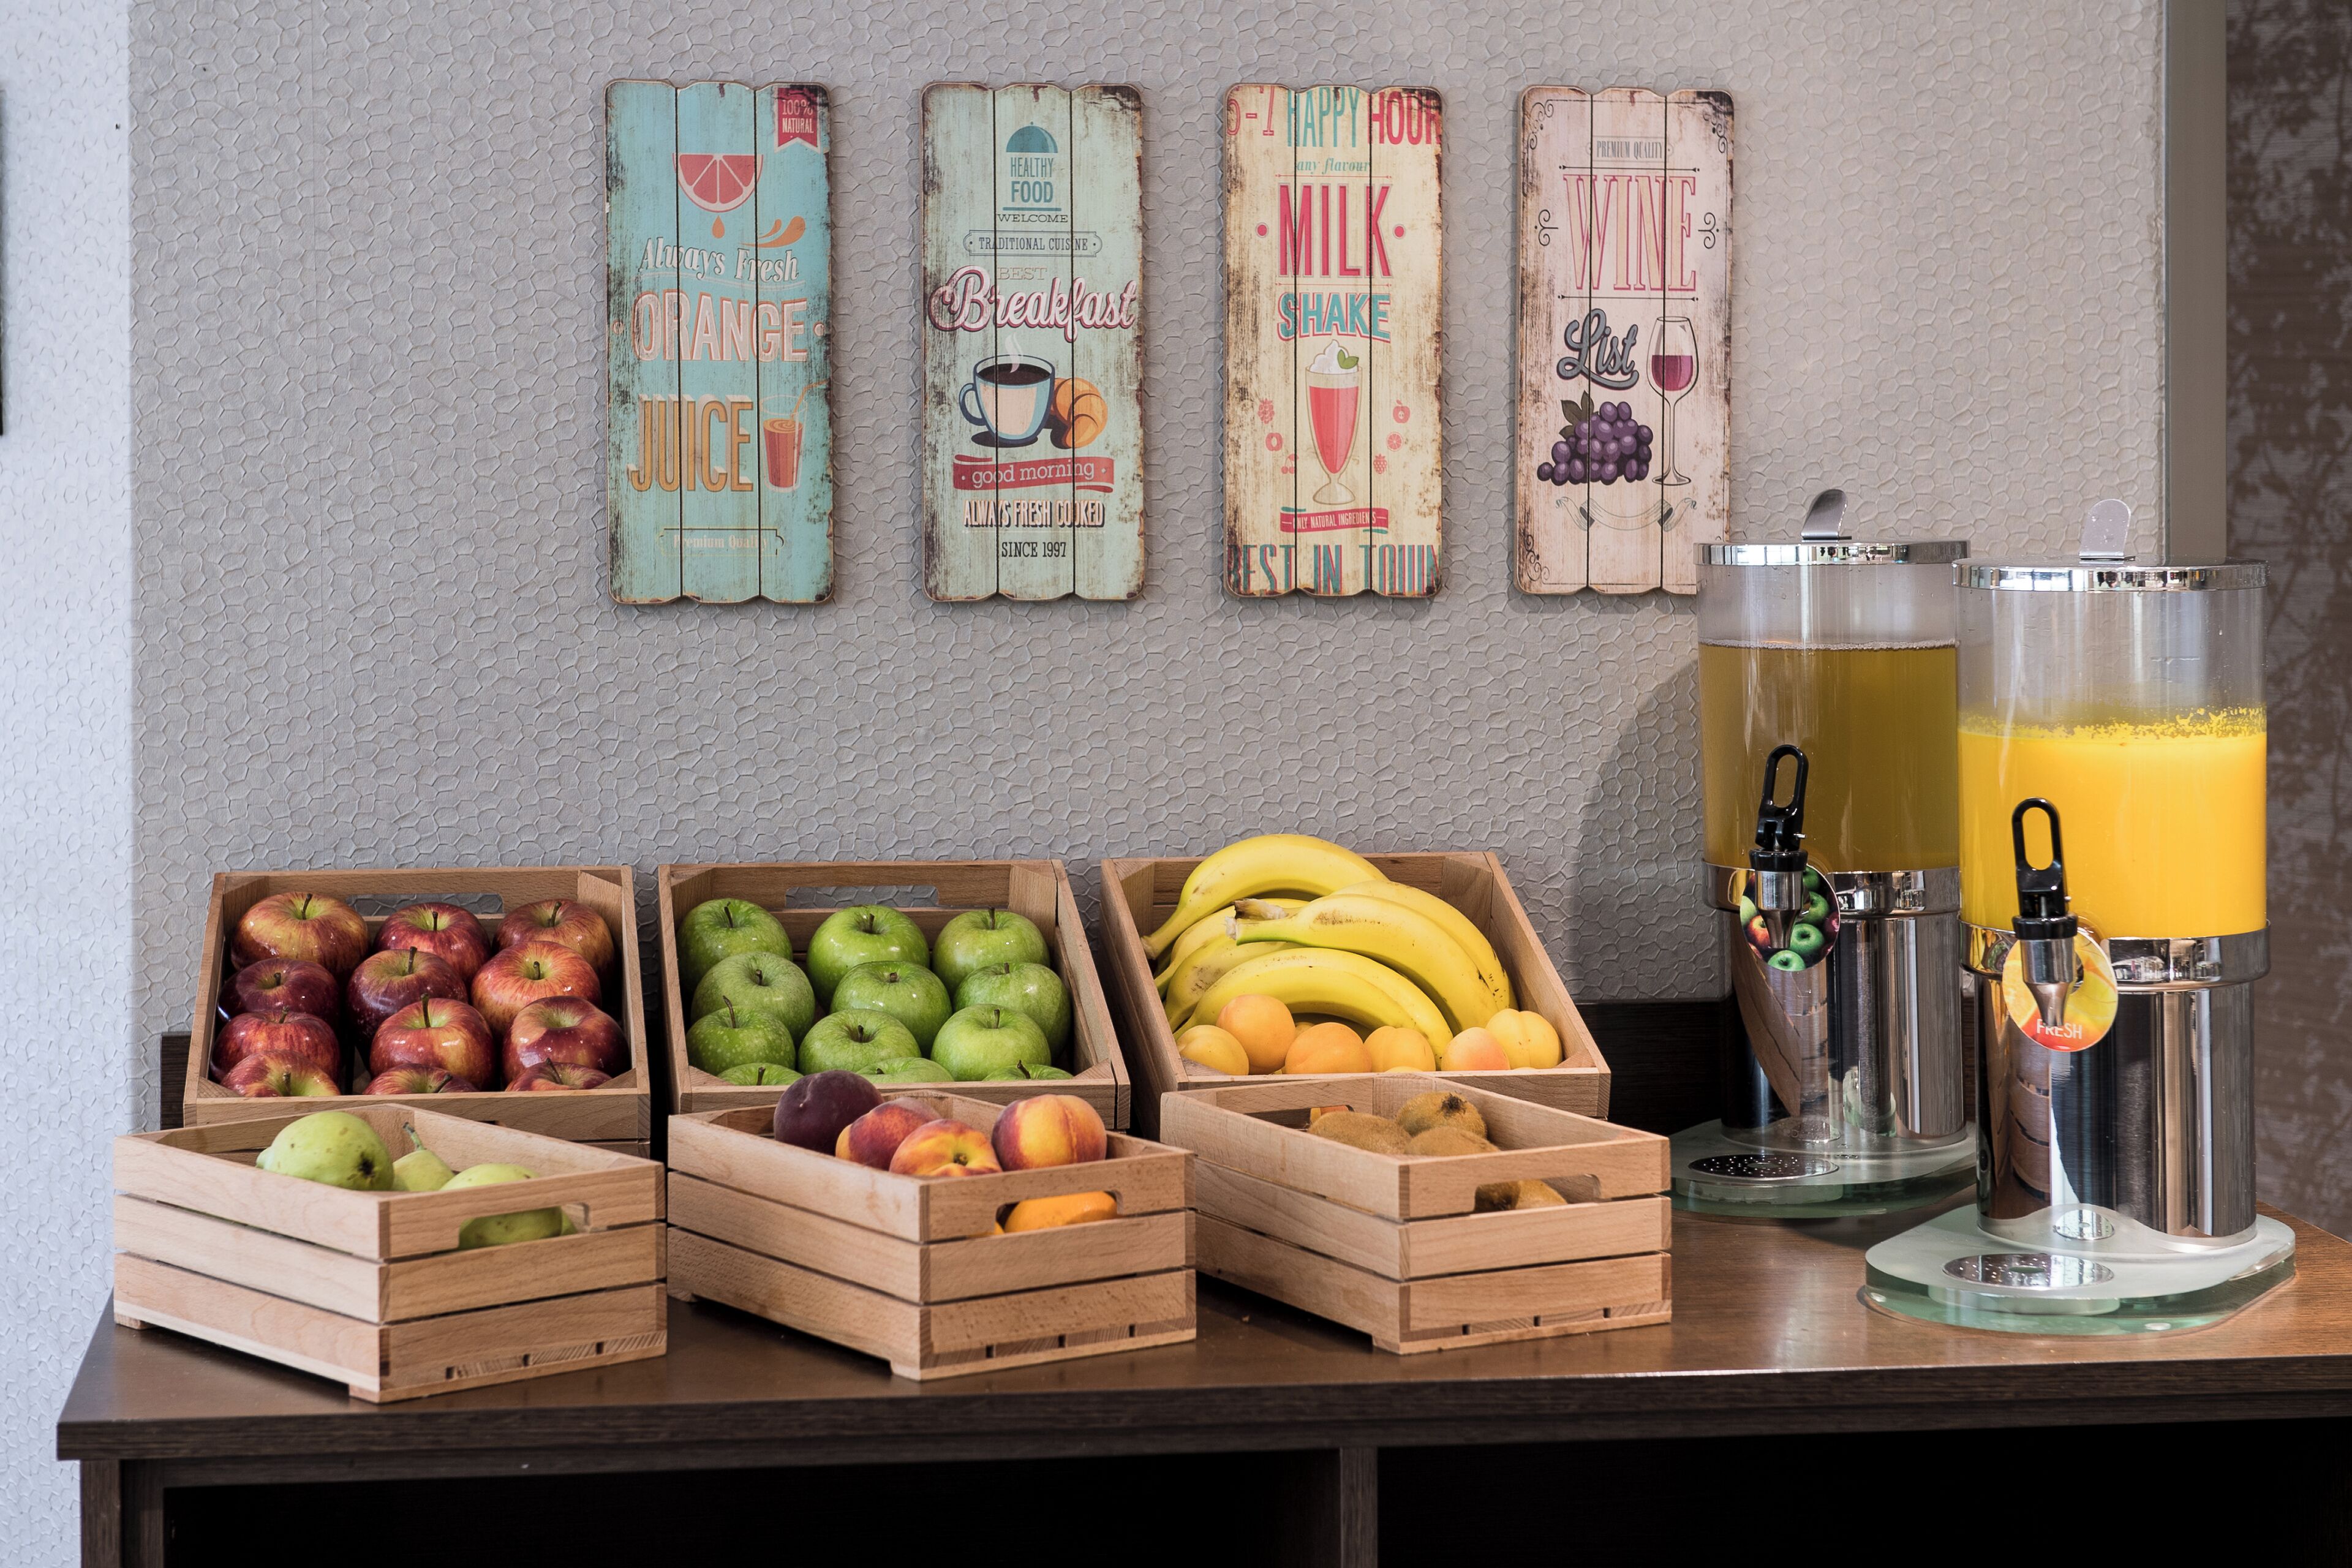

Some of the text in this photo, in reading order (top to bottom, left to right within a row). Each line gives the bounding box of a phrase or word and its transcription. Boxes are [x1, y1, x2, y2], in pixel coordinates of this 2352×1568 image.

[782, 99, 814, 116] 100%
[1287, 87, 1360, 147] HAPPY
[1367, 91, 1442, 145] HOUR
[782, 118, 814, 134] NATURAL
[1596, 140, 1662, 160] PREMIUM QUALITY
[1010, 157, 1054, 178] HEALTHY
[1297, 157, 1370, 175] any flavour
[1011, 180, 1054, 203] FOOD
[997, 214, 1068, 223] WELCOME
[1278, 183, 1393, 279] MILK
[1562, 174, 1696, 292] WINE
[979, 236, 1088, 251] TRADITIONAL CUISNE
[639, 237, 799, 283] Always Fresh
[997, 267, 1047, 281] BEST
[928, 265, 1137, 343] Breakfast
[631, 289, 808, 363] ORANGE
[1277, 292, 1391, 344] SHAKE
[1556, 308, 1640, 391] List
[627, 394, 754, 492] JUICE
[971, 459, 1095, 488] good morning
[963, 499, 1105, 527] ALWAYS FRESH COOKED
[1311, 514, 1337, 529] NATURAL
[1338, 511, 1376, 526] INGREDIENS
[674, 533, 769, 551] Premium Qualiy
[1001, 541, 1067, 558] SINCE 1997
[1314, 544, 1343, 596] IN
[2036, 1018, 2082, 1039] FRESH
